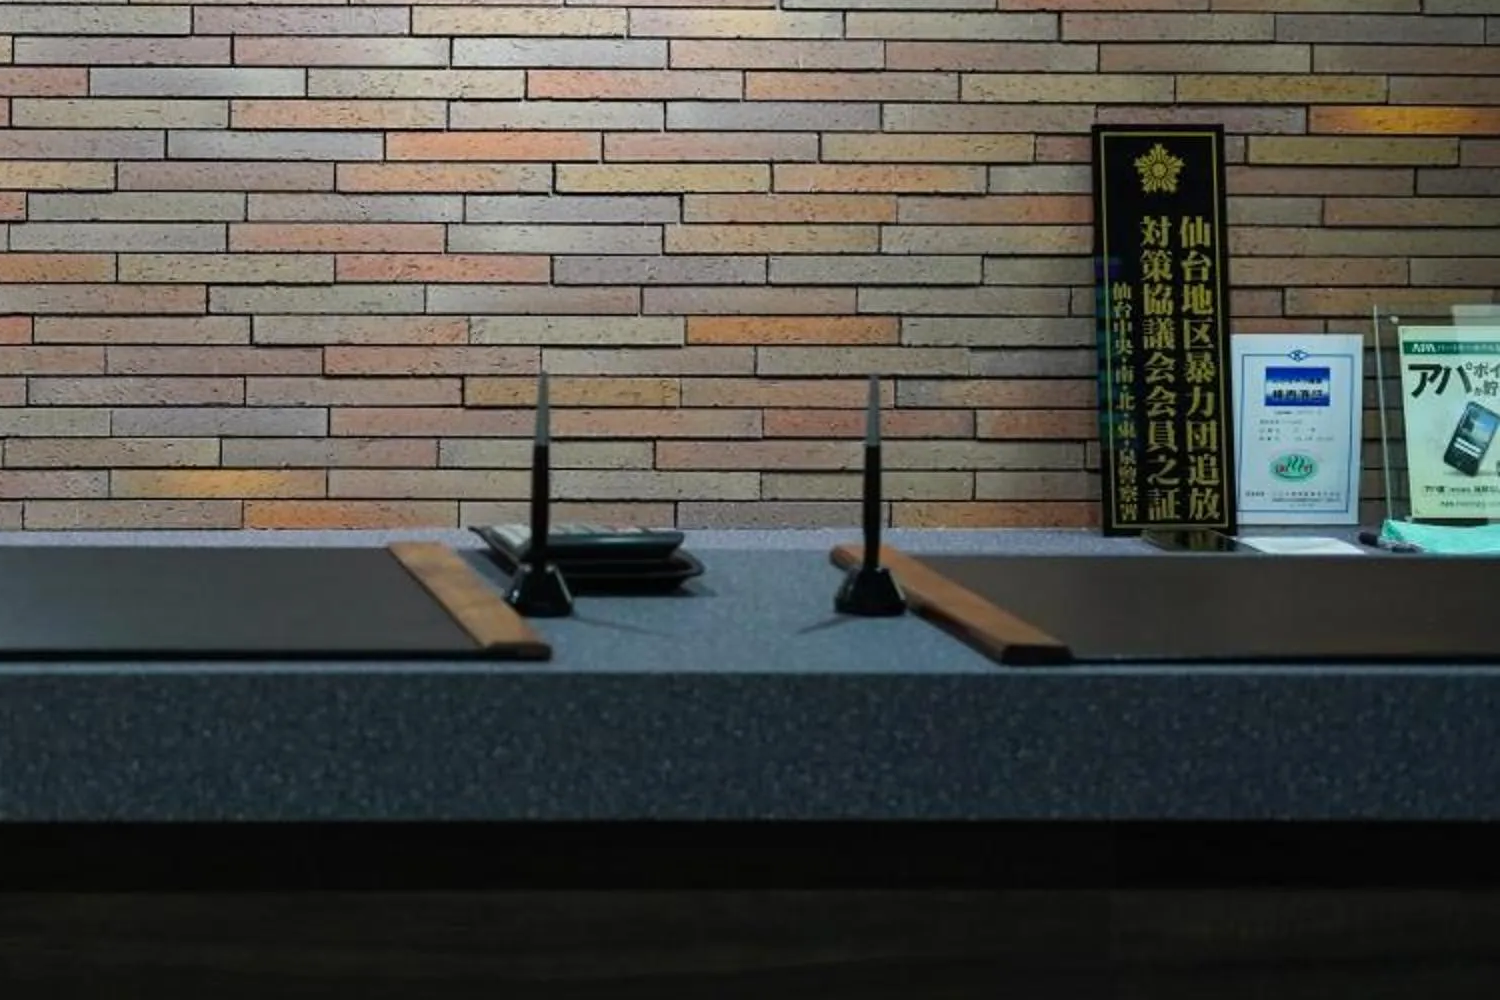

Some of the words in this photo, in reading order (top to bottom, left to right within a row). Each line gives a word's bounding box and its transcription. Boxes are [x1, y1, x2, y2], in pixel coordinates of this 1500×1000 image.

[1139, 214, 1182, 521] 対策協議会会員之証
[1179, 214, 1221, 521] 仙台地区暴力団追放
